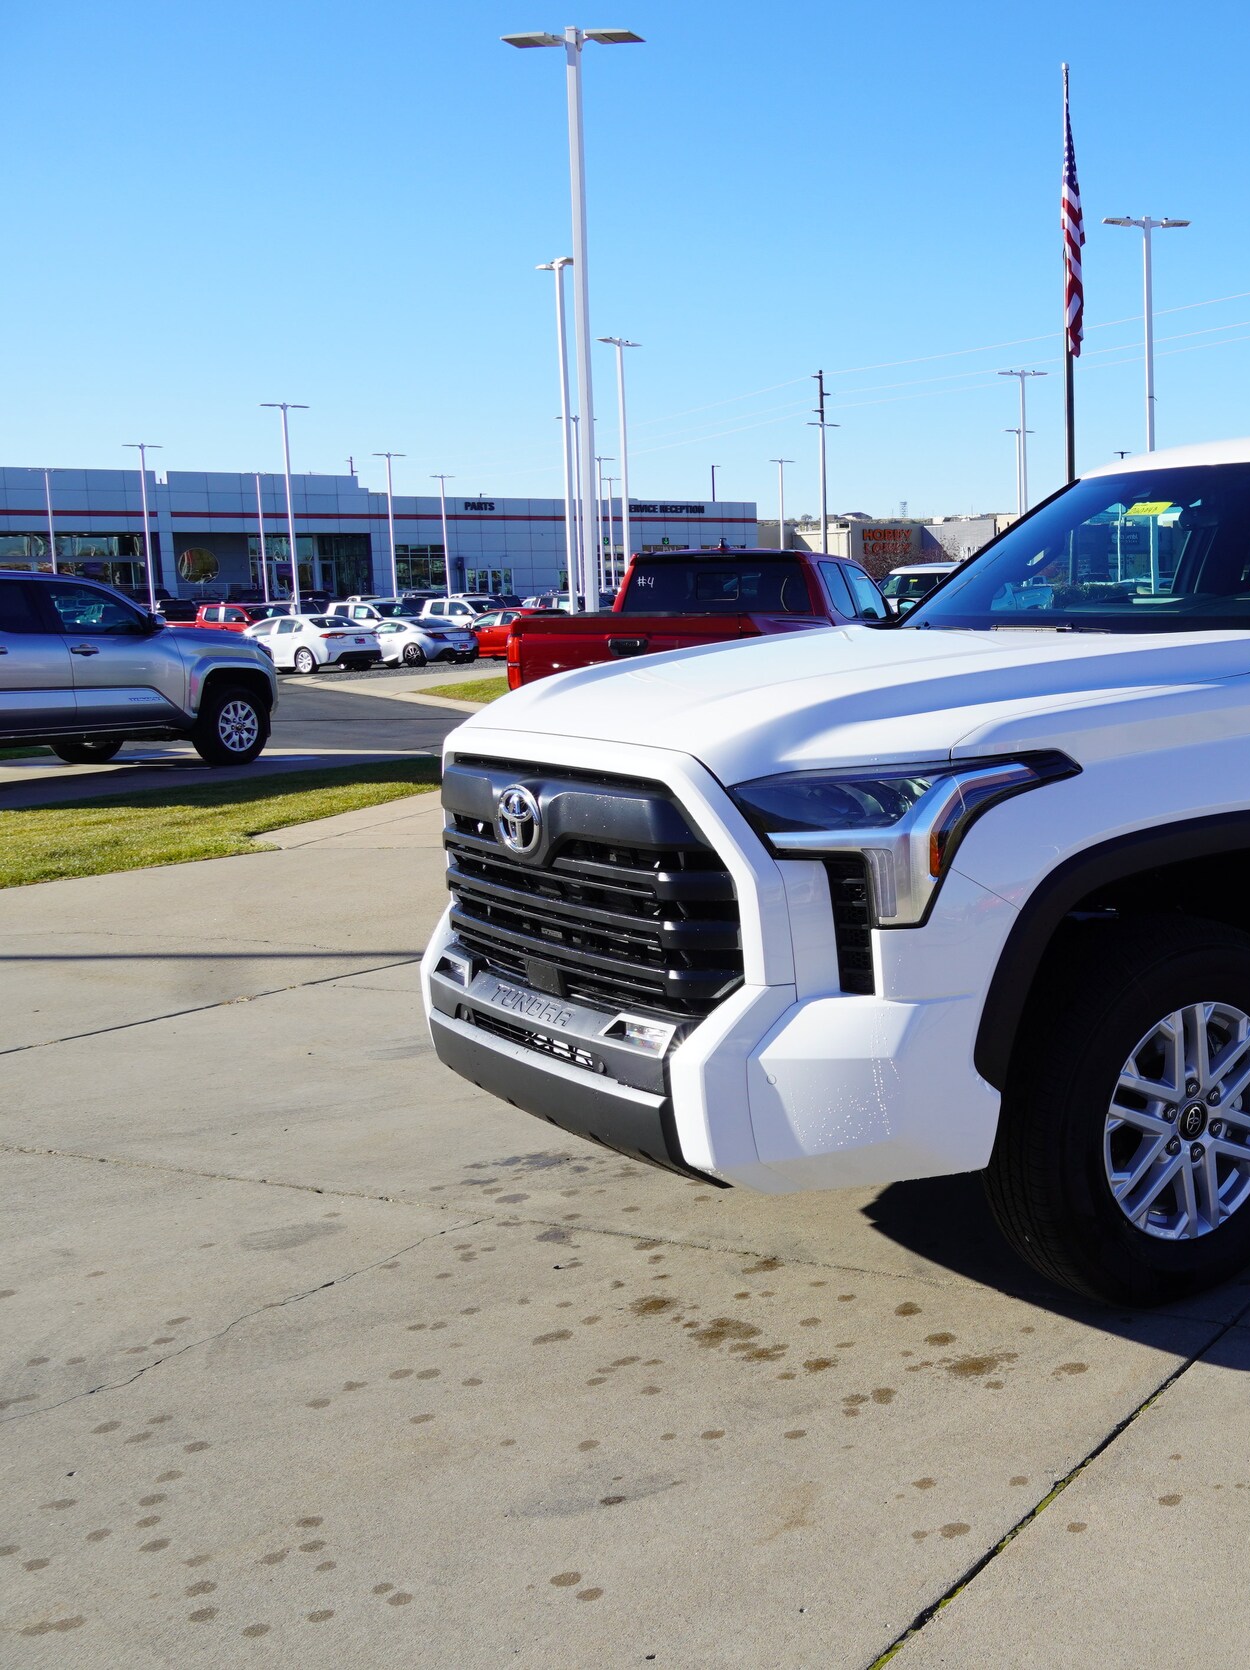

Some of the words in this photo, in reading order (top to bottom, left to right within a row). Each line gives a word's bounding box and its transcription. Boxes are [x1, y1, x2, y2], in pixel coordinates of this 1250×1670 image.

[464, 502, 495, 511] PARTS
[629, 504, 658, 513] ERVICE
[659, 505, 705, 514] RECEPTION
[862, 529, 912, 541] HOBBY
[637, 576, 655, 588] #4
[491, 984, 576, 1027] TUNDRA
